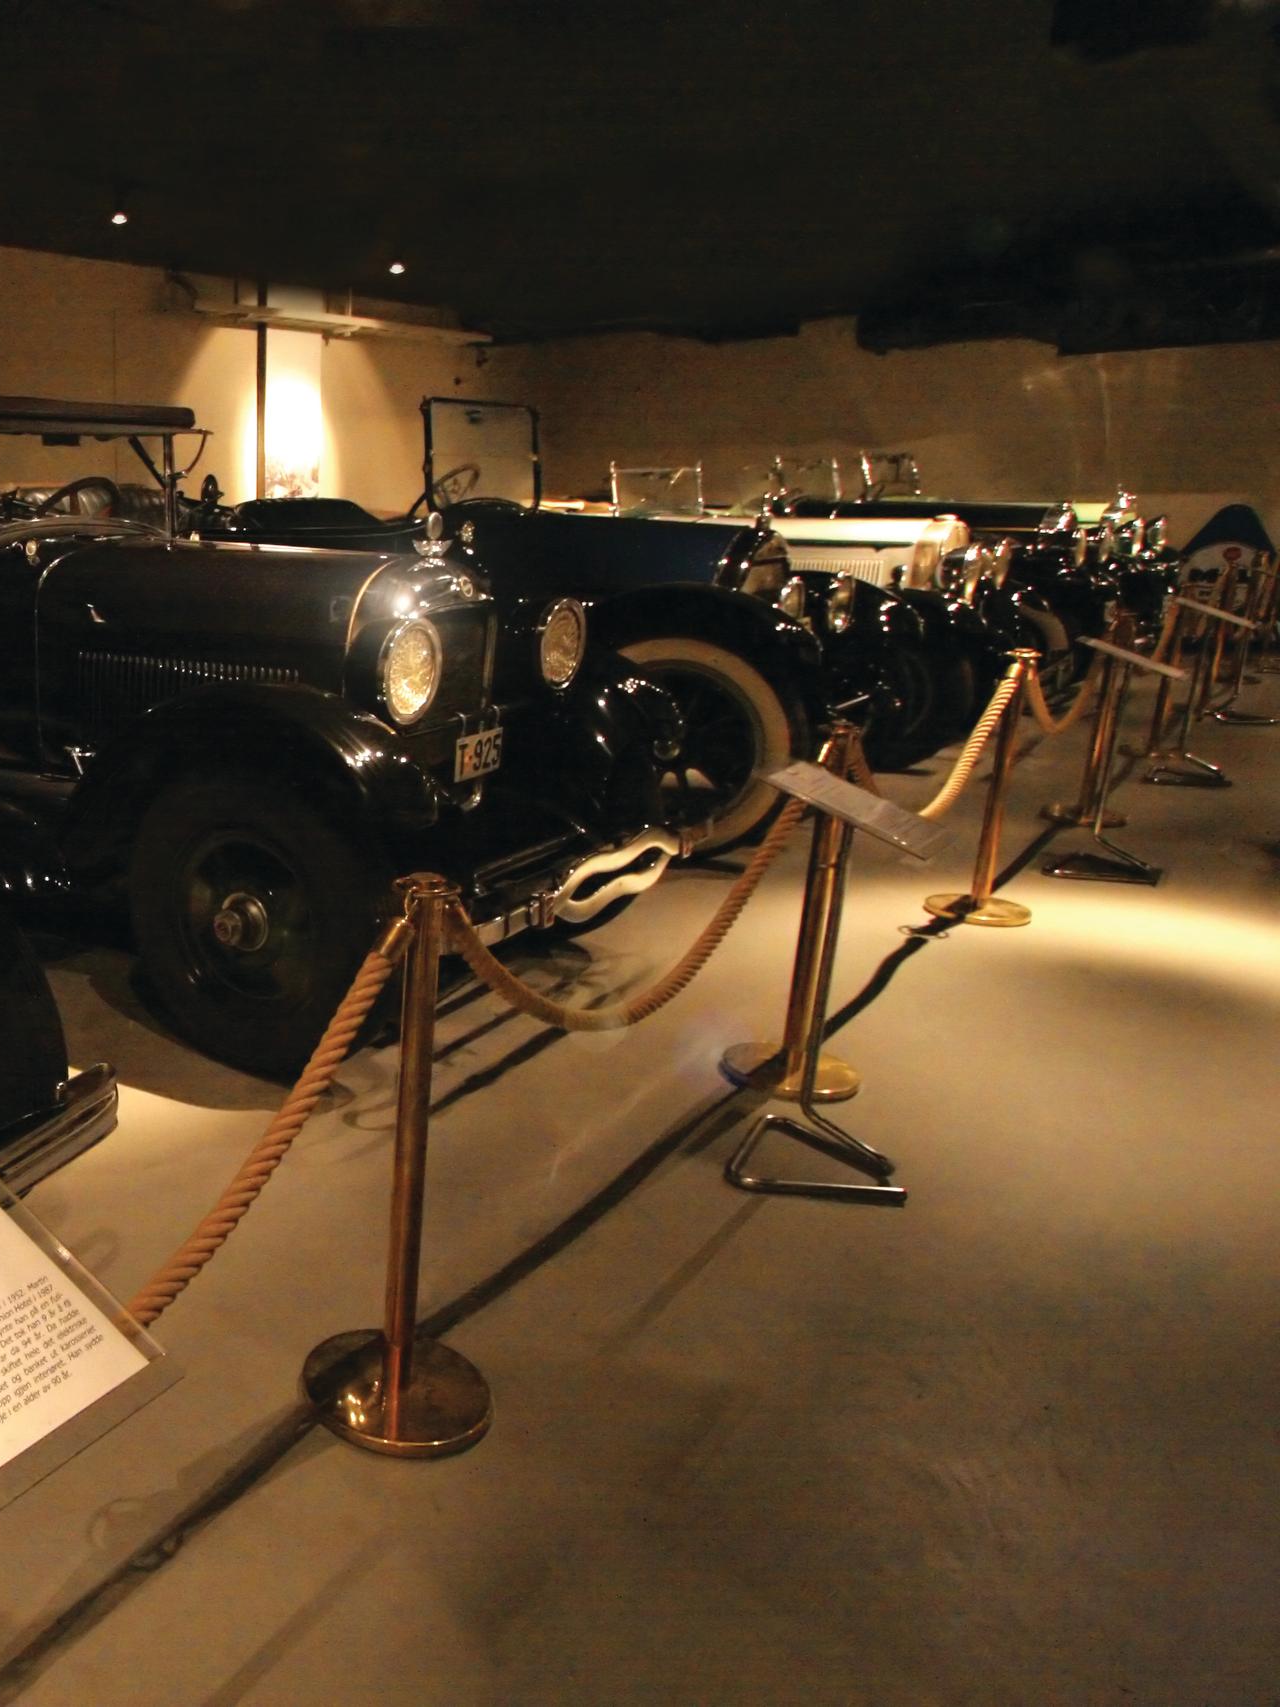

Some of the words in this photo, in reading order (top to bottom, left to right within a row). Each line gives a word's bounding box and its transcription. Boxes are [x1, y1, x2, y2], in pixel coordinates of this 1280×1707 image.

[13, 1297, 33, 1313] Hotel
[14, 1314, 29, 1325] han
[0, 1336, 14, 1349] Det
[27, 1319, 41, 1332] han
[23, 1356, 48, 1376] banket
[23, 1390, 40, 1406] alder
